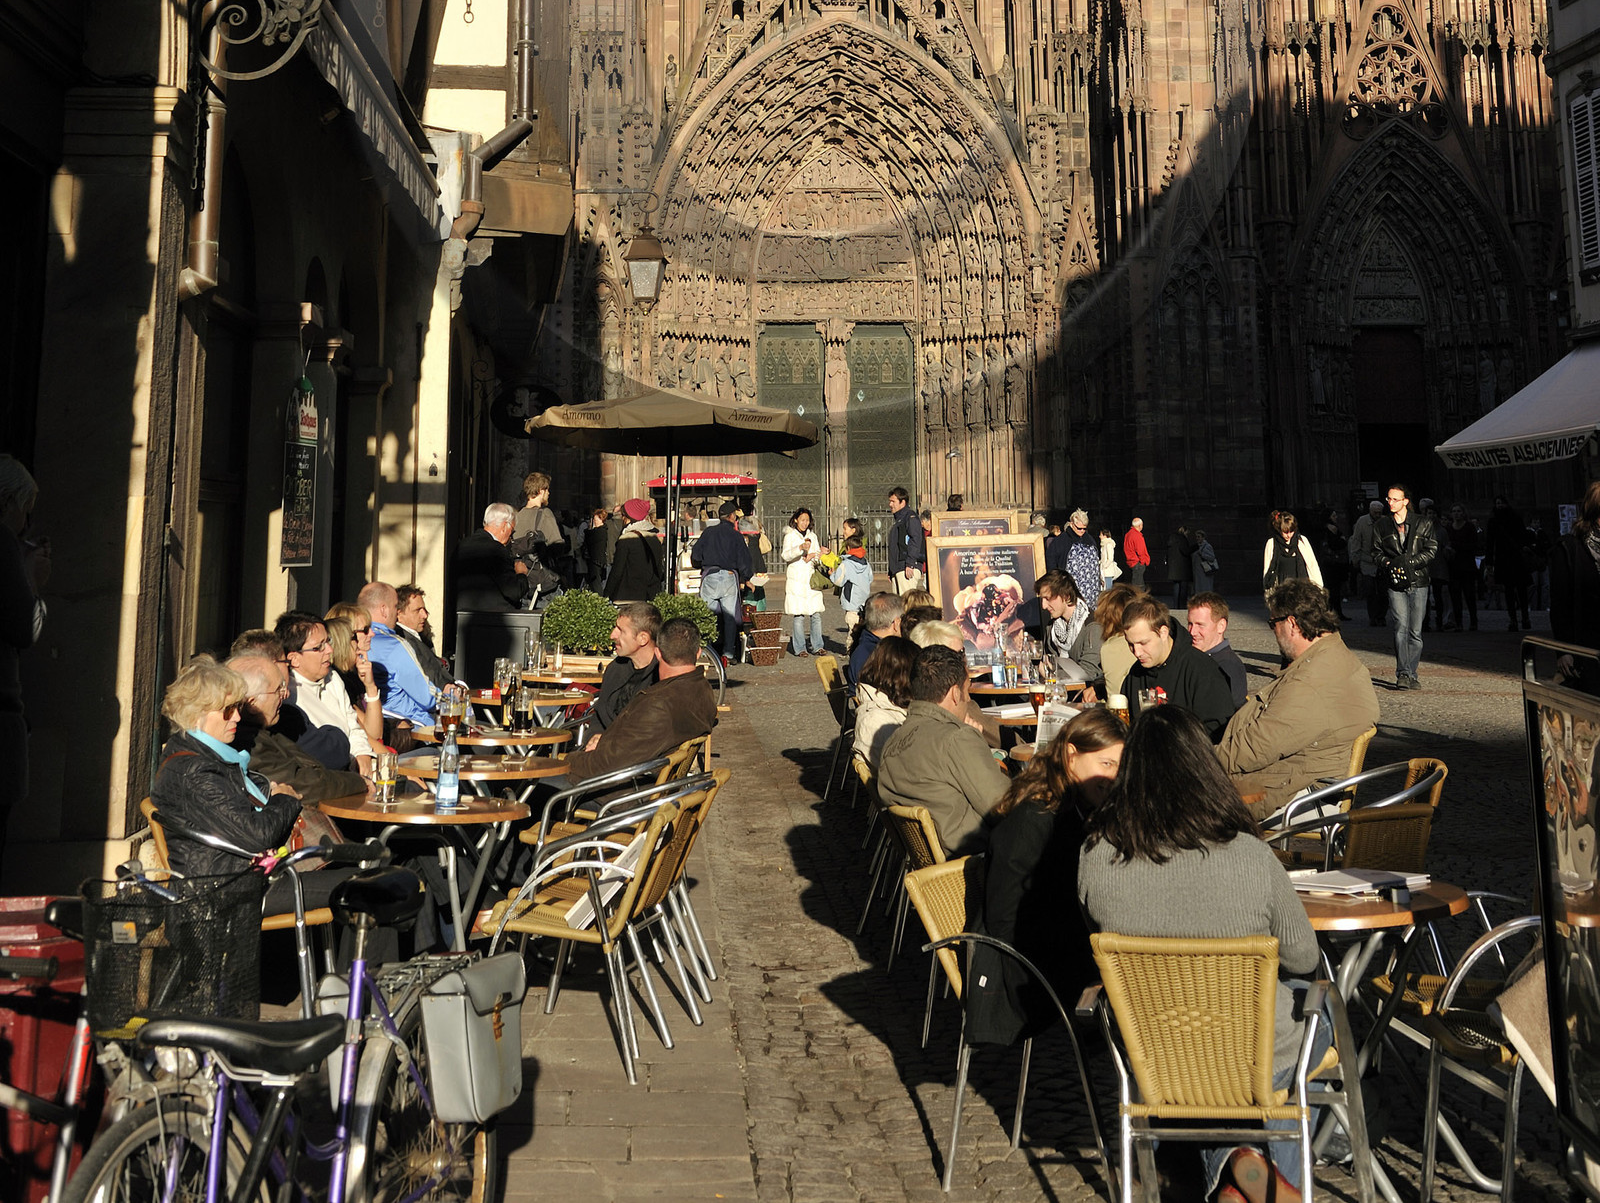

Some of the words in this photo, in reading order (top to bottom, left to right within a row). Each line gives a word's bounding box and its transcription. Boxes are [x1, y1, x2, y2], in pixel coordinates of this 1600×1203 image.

[728, 409, 773, 424] Amorino
[1513, 435, 1585, 462] ALSACIENNES
[720, 476, 740, 484] chauds
